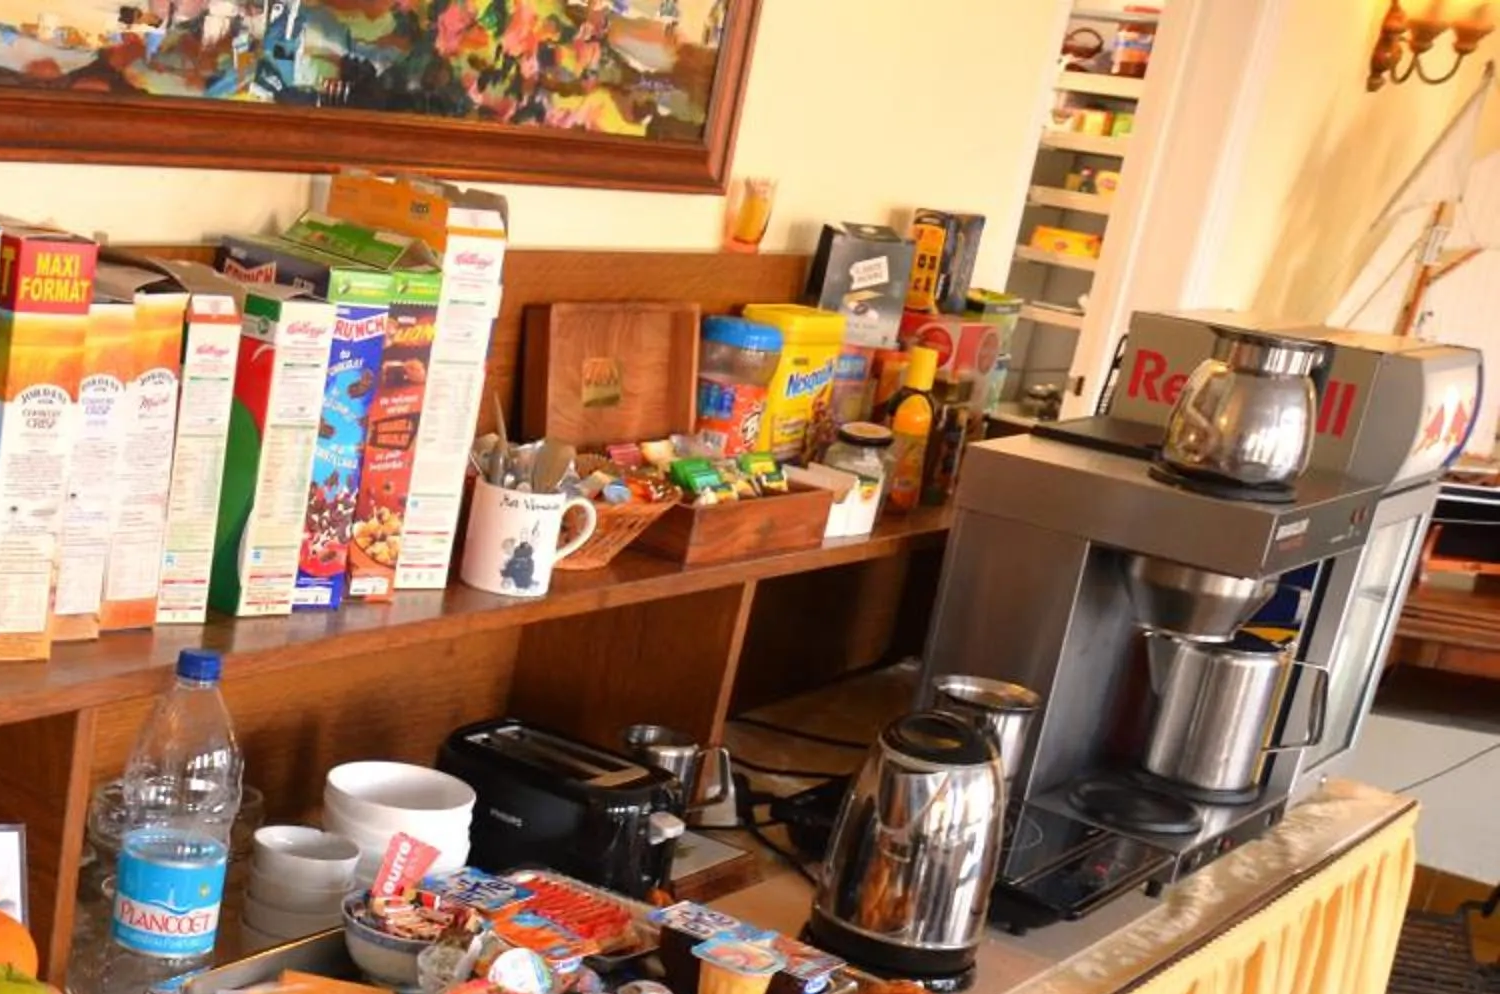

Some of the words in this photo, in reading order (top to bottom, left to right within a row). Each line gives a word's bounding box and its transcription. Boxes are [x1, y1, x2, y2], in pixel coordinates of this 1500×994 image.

[35, 252, 81, 277] MAXI
[19, 278, 91, 303] FORMAT
[333, 316, 385, 339] RUNCH
